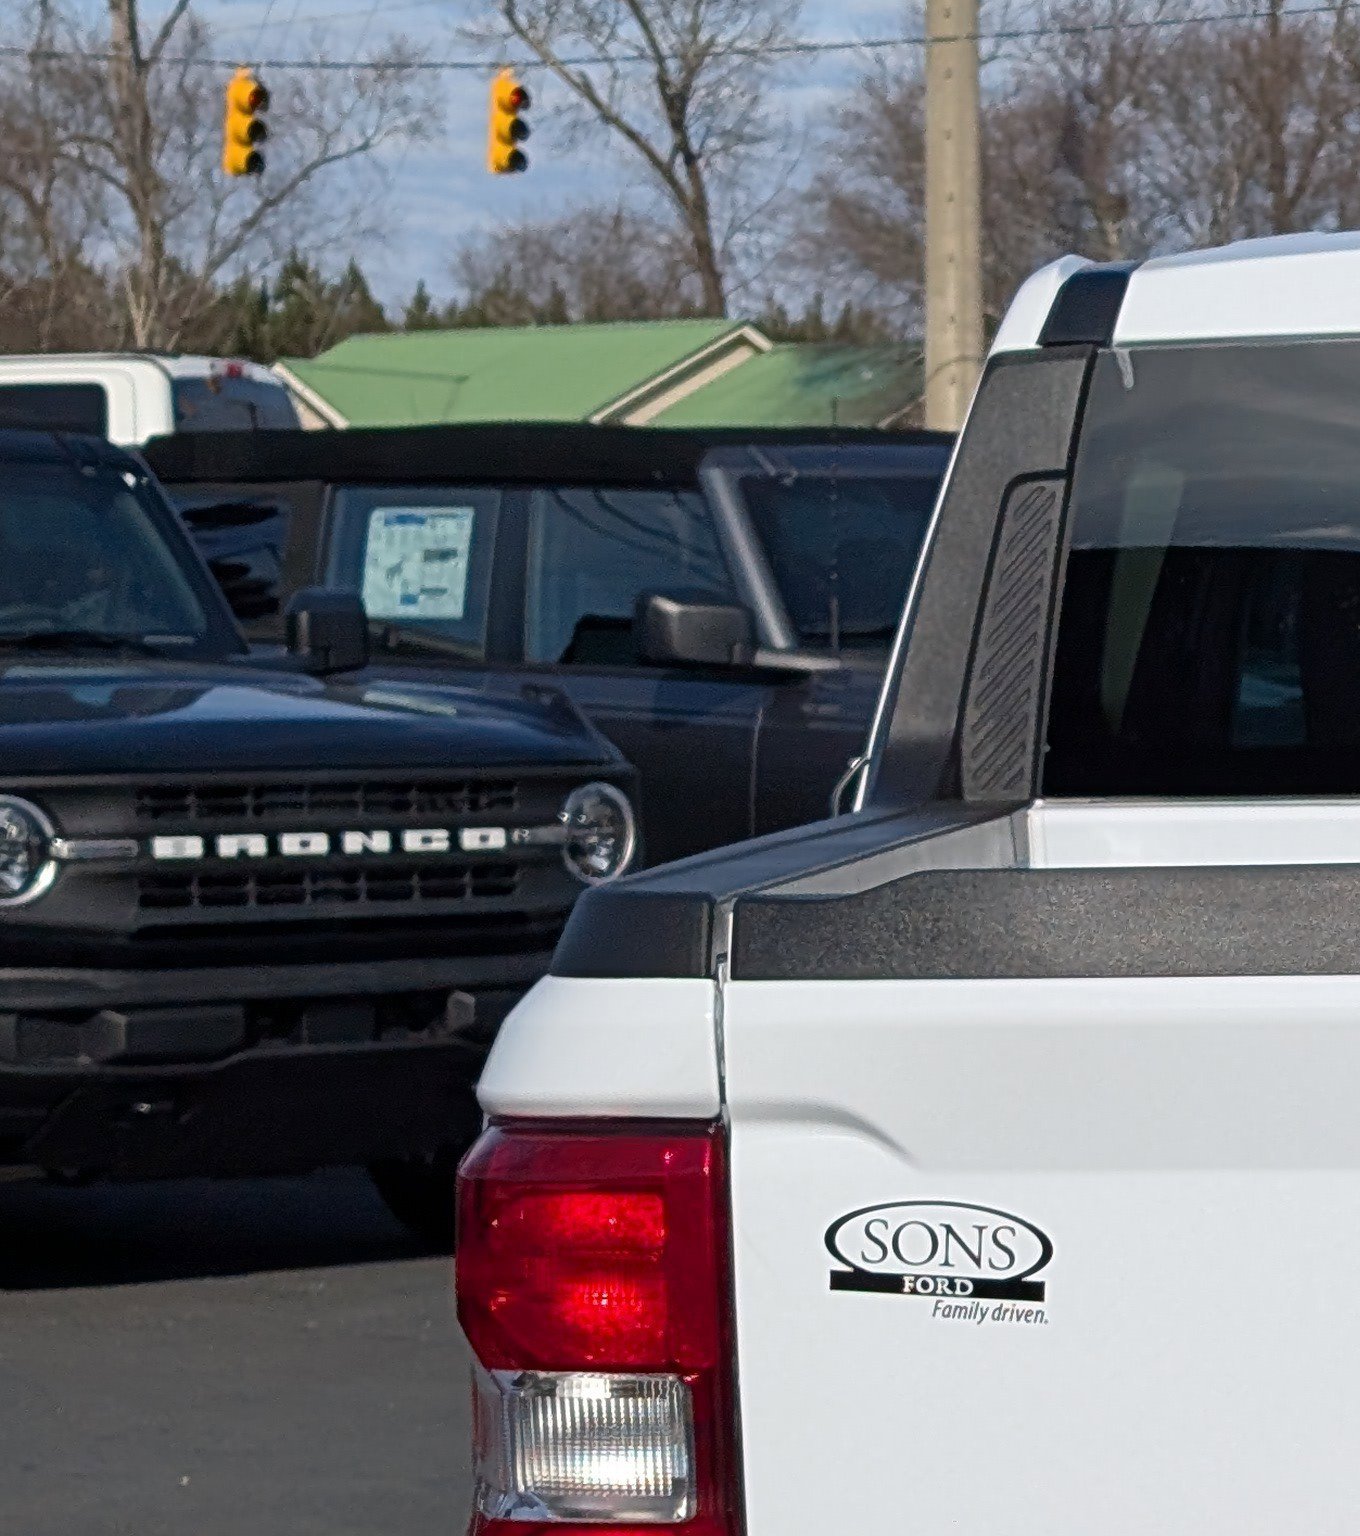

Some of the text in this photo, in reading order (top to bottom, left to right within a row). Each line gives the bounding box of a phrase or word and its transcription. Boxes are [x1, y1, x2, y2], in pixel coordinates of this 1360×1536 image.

[152, 827, 506, 860] BRONCO
[860, 1217, 1017, 1271] SONS
[902, 1275, 974, 1297] FORD
[931, 1299, 1049, 1326] Family driven.
